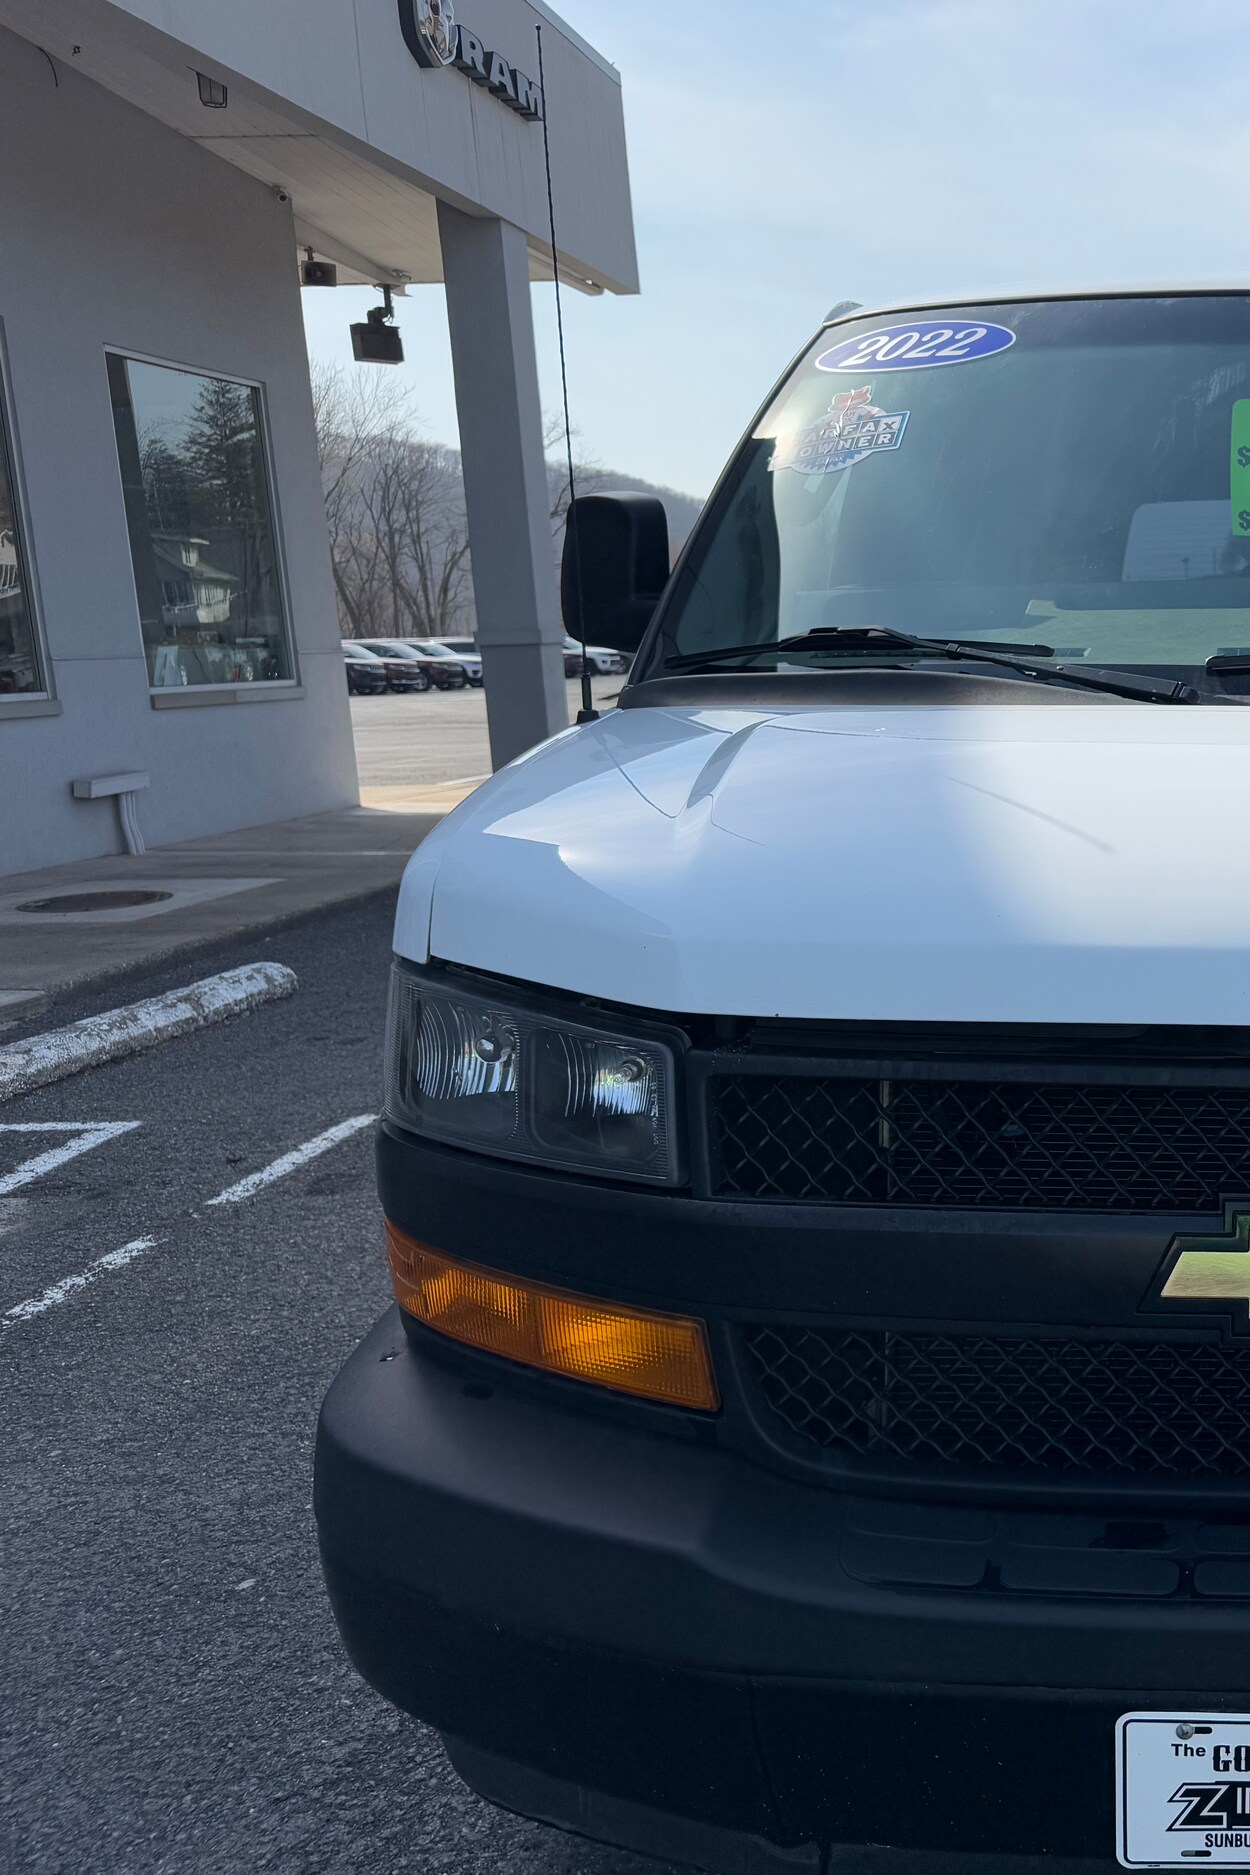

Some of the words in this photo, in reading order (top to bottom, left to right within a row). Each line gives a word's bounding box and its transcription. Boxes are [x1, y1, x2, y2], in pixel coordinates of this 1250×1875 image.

[457, 25, 543, 121] RAM
[838, 327, 988, 368] 2022
[799, 433, 892, 457] OWNER
[1237, 445, 1250, 468] $
[1171, 1743, 1206, 1757] The
